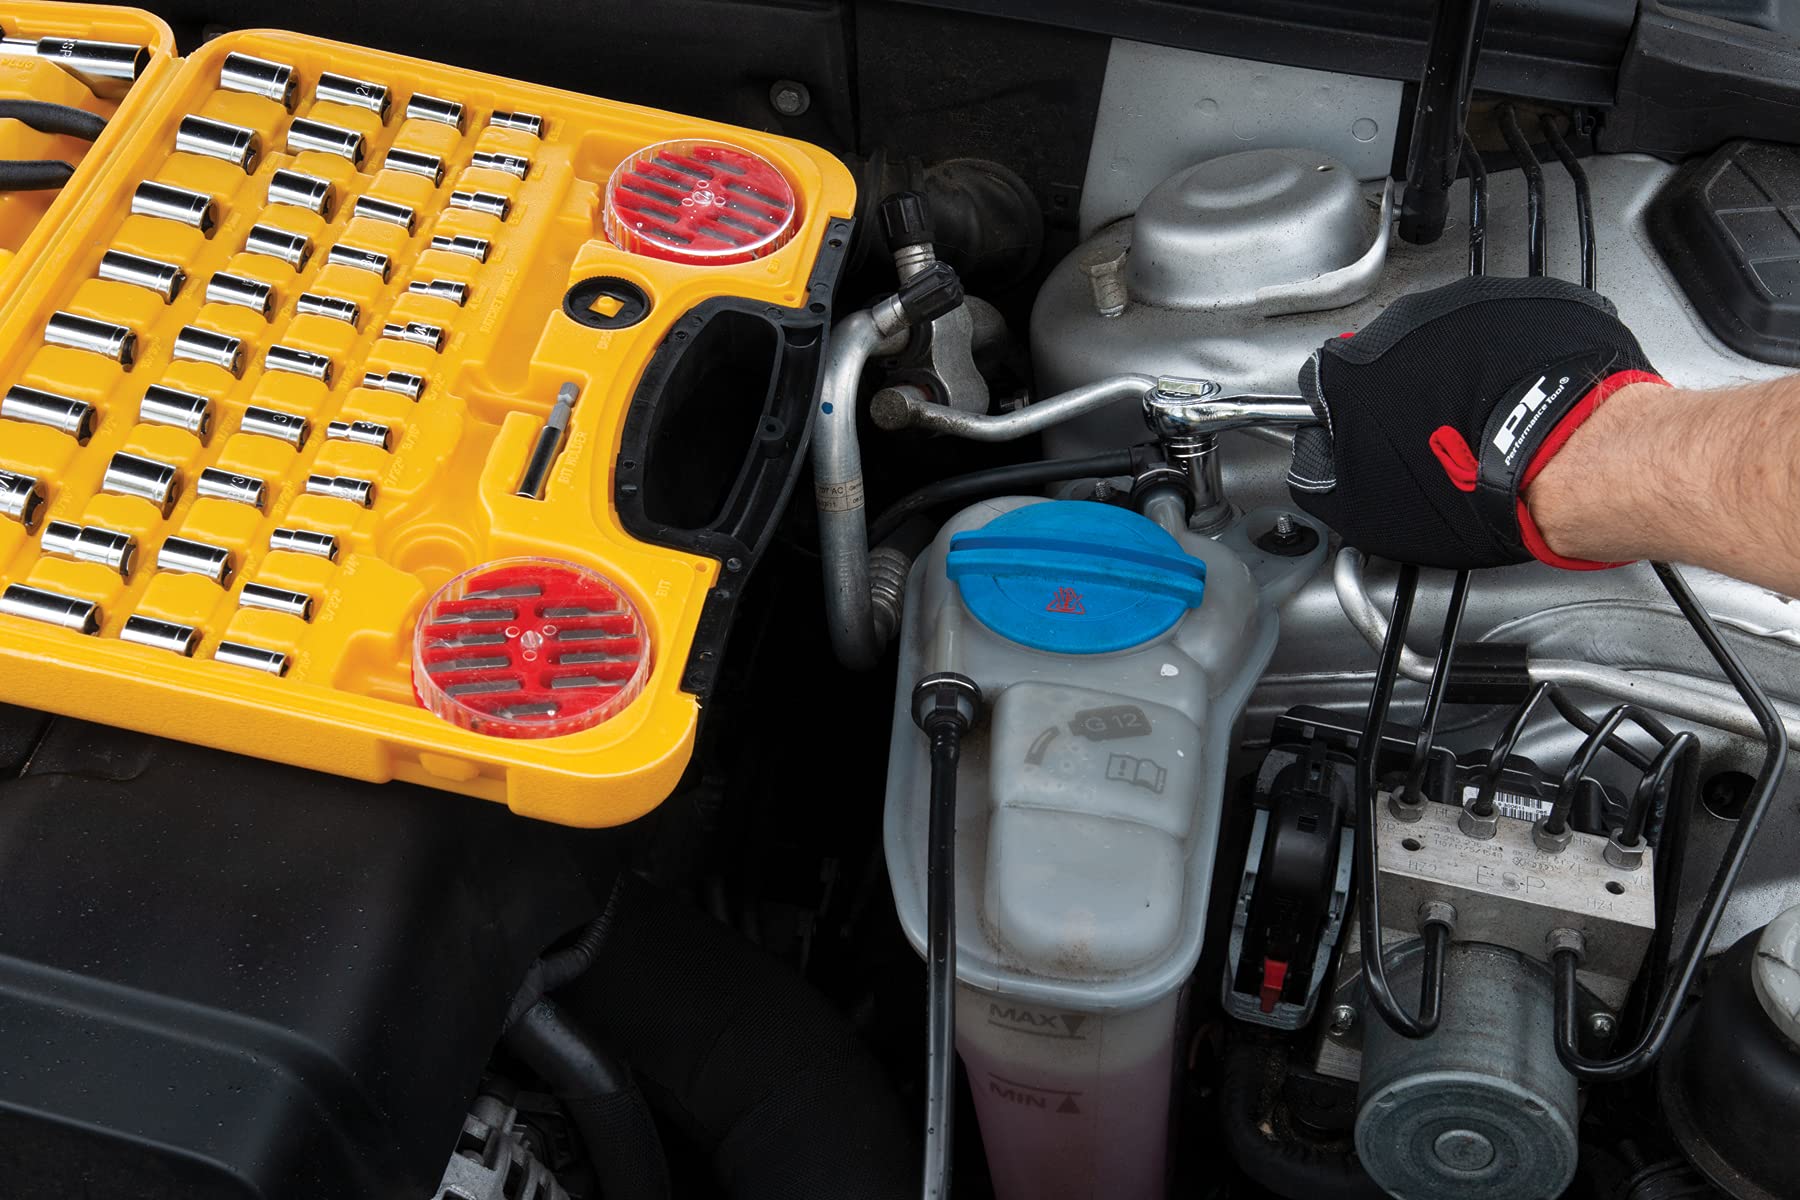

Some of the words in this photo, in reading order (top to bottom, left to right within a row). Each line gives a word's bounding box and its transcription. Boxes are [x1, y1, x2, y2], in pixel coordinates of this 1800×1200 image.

[1504, 402, 1549, 466] Performance
[1084, 716, 1107, 732] G
[1111, 712, 1142, 729] 12
[1572, 835, 1592, 847] HR
[989, 1003, 1058, 1028] MAX
[989, 1081, 1047, 1109] MIN
